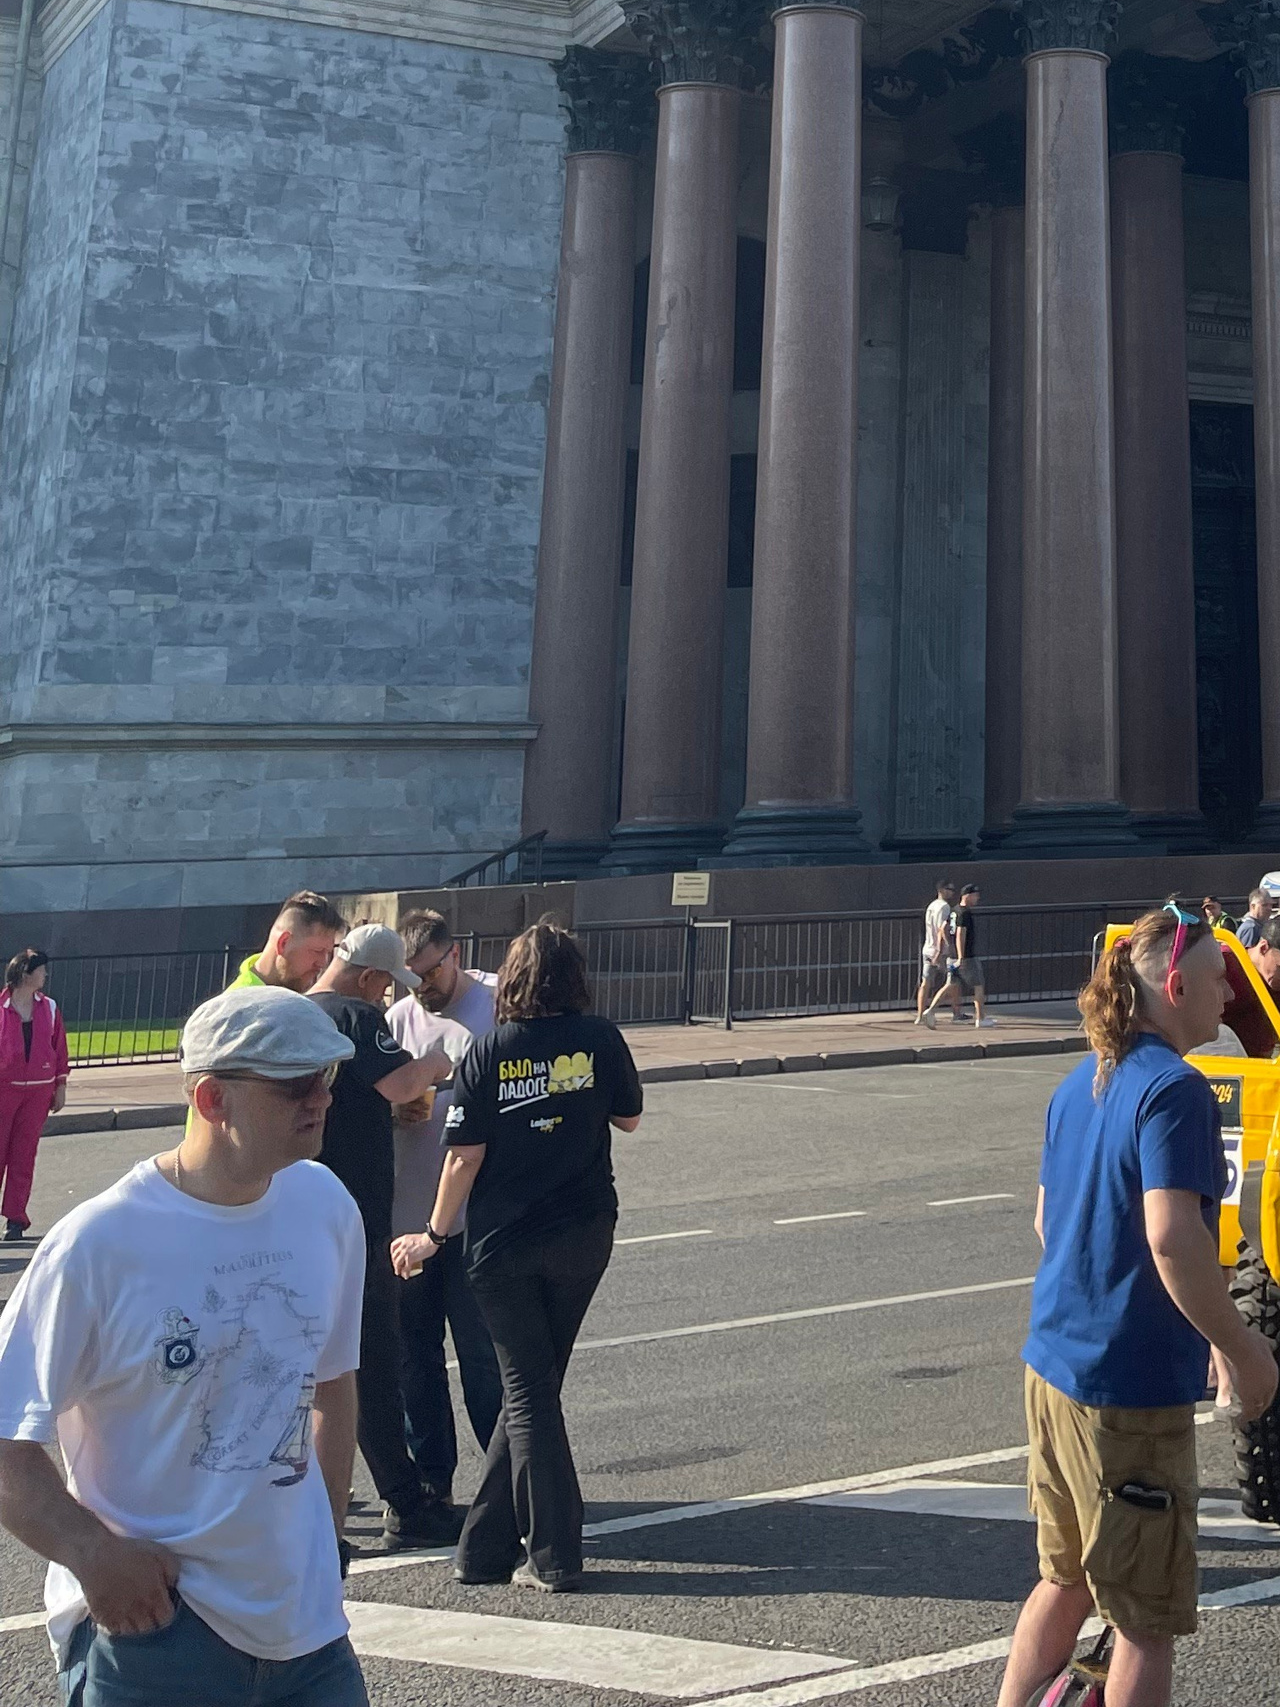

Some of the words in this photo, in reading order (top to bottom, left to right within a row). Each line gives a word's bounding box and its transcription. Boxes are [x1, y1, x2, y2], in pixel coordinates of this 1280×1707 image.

[498, 1058, 533, 1081] БЫЛ
[533, 1061, 547, 1074] НА
[497, 1076, 548, 1101] ЛАДОГЕ
